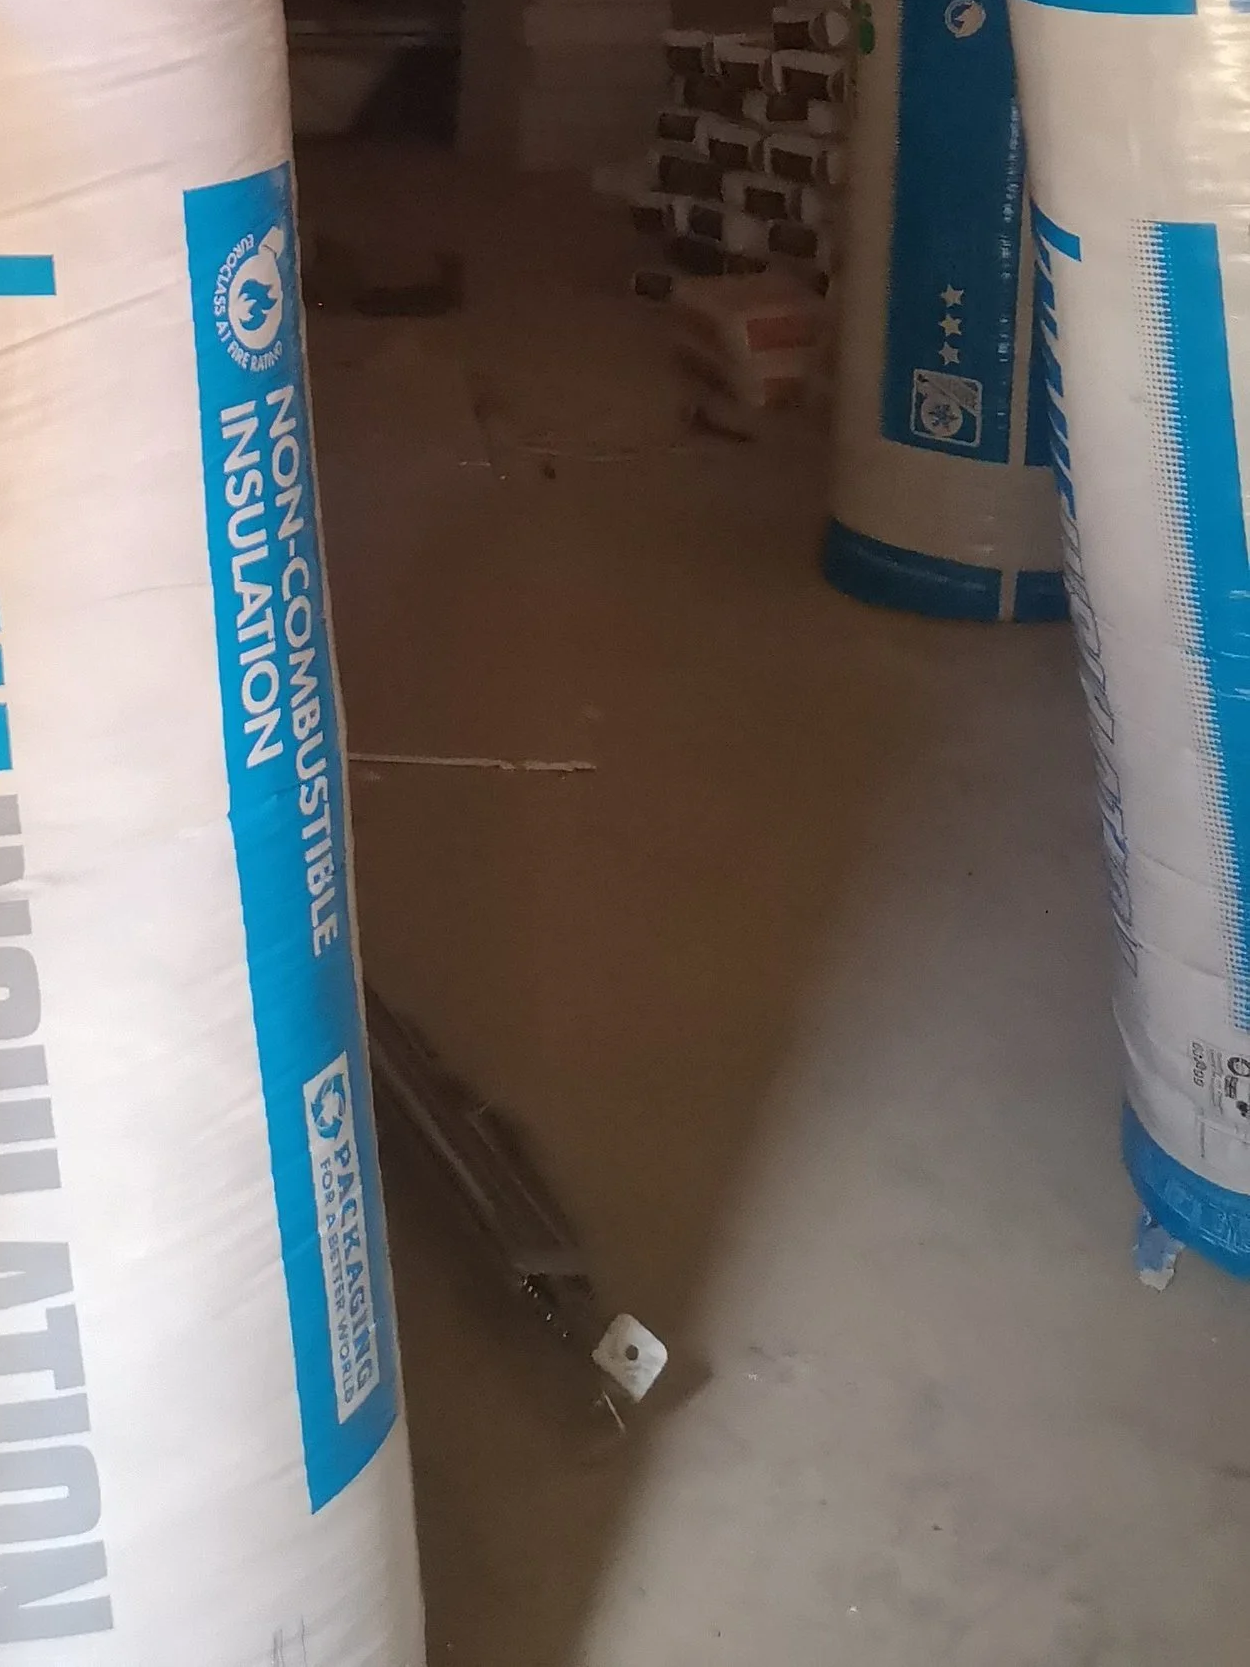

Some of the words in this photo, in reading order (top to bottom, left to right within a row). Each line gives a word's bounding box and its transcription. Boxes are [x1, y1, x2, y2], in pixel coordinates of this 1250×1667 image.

[214, 233, 255, 317] EUROCLASS
[219, 400, 283, 769] INSULATION
[265, 384, 338, 958] NON-COMBUSTIBLE
[319, 1156, 337, 1207] FOR
[326, 1212, 336, 1233] A
[334, 1145, 373, 1391] PACKAGING
[337, 1315, 354, 1405] WORLD
